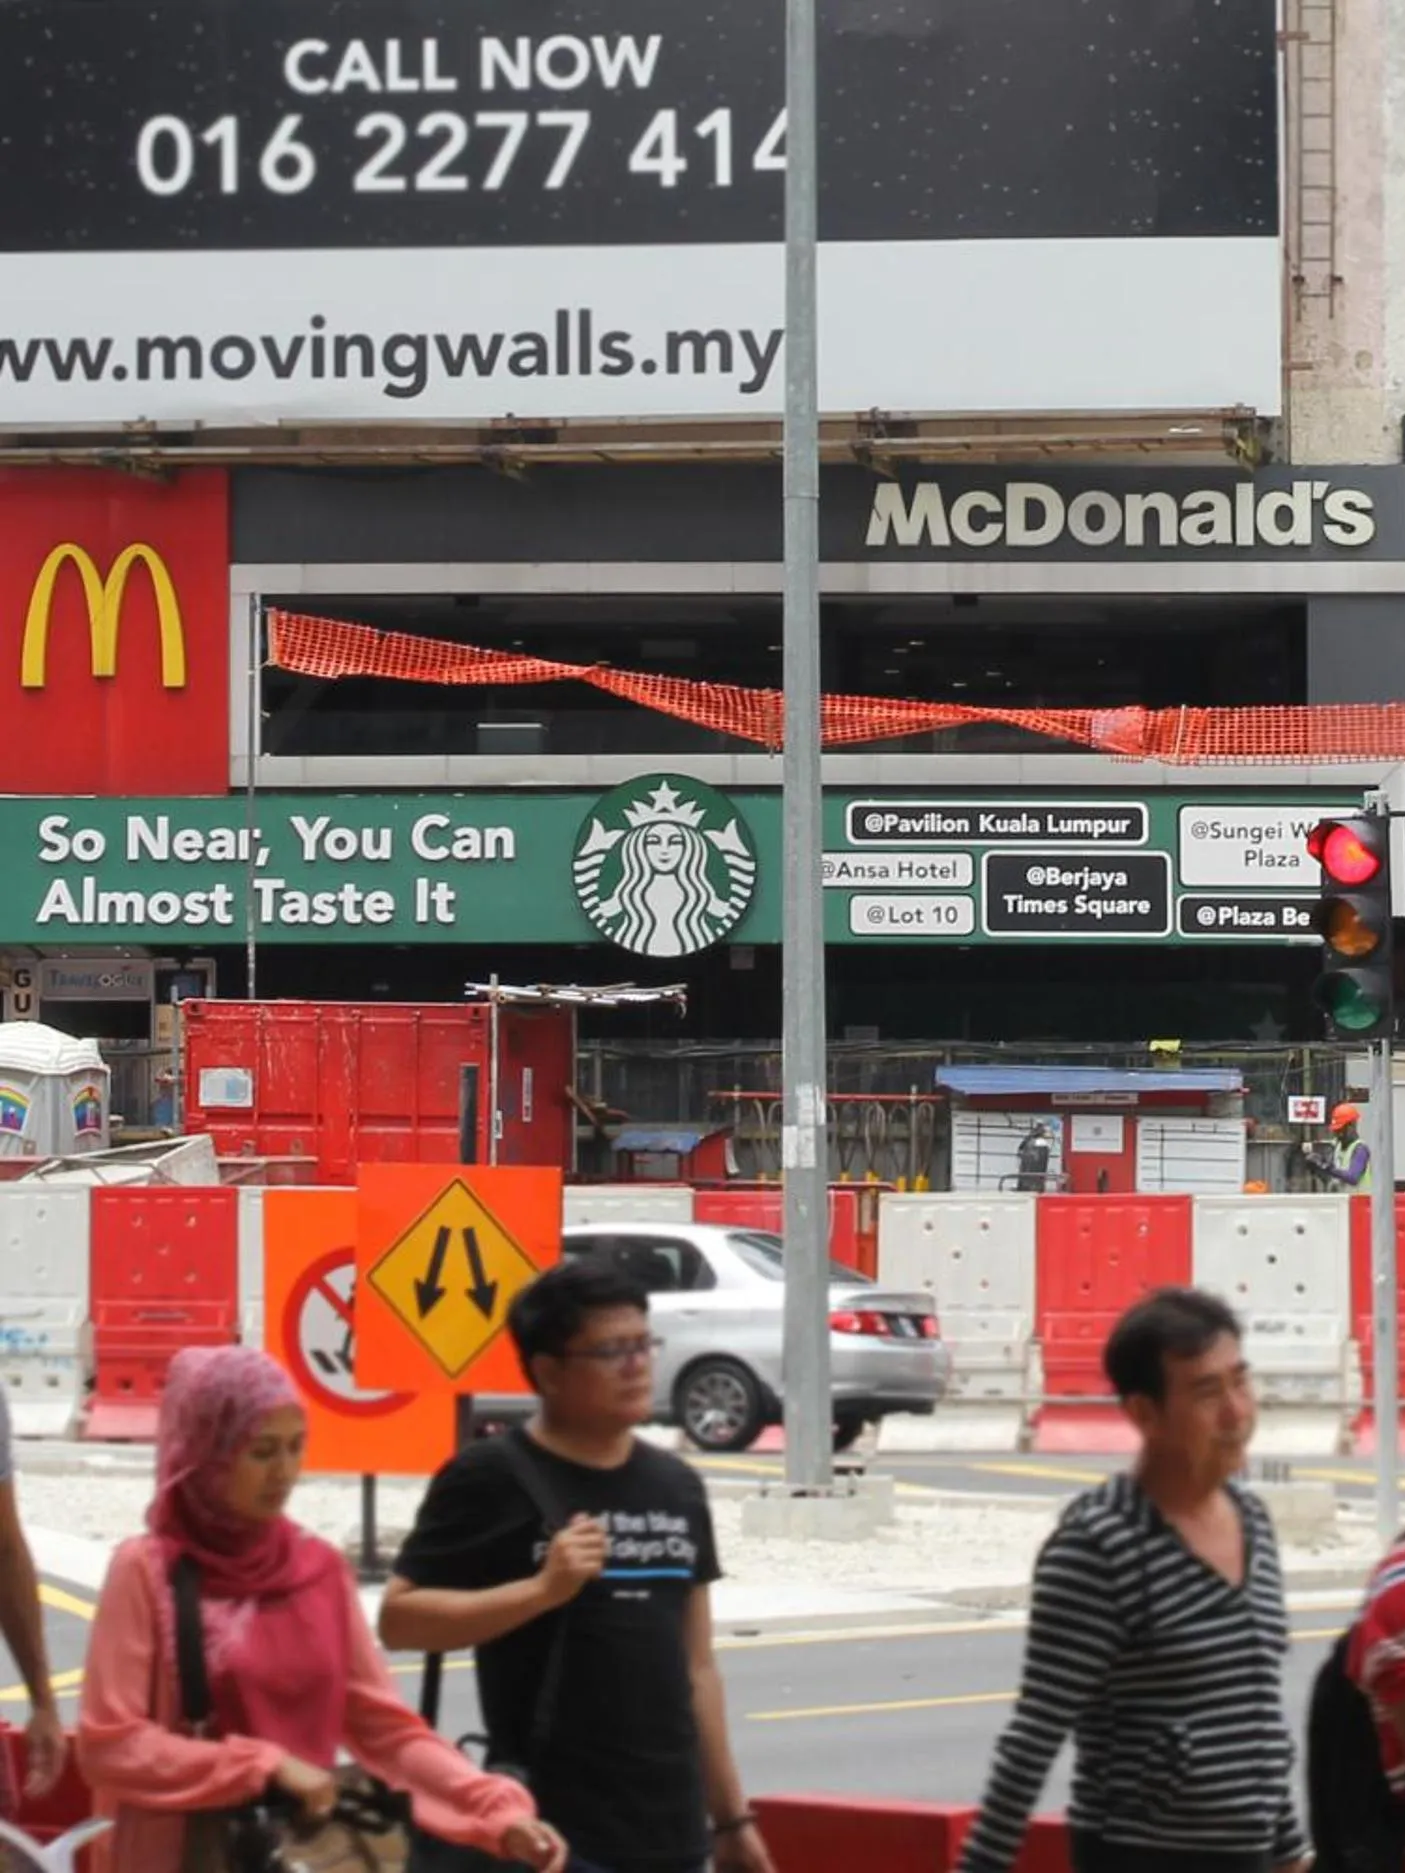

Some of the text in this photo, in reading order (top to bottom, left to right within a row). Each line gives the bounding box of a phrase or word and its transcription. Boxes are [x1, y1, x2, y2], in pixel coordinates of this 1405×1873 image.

[284, 35, 662, 94] CALL NOW
[136, 115, 316, 195] 016
[353, 112, 592, 192] 2277
[865, 479, 1377, 548] McDonald's
[864, 813, 1131, 838] @Pavilion Kuala Lumpur
[1190, 821, 1314, 845] @Sungei W
[37, 814, 516, 868] So Near, You Can
[822, 860, 957, 880] @Ansa Hotel
[1244, 849, 1300, 868] Plaza
[1026, 867, 1128, 890] @Berjaya
[36, 878, 456, 925] Almost Taste It
[1003, 894, 1151, 919] Times Square
[866, 906, 958, 925] @Lot 10
[1196, 905, 1311, 926] @Plaza Be
